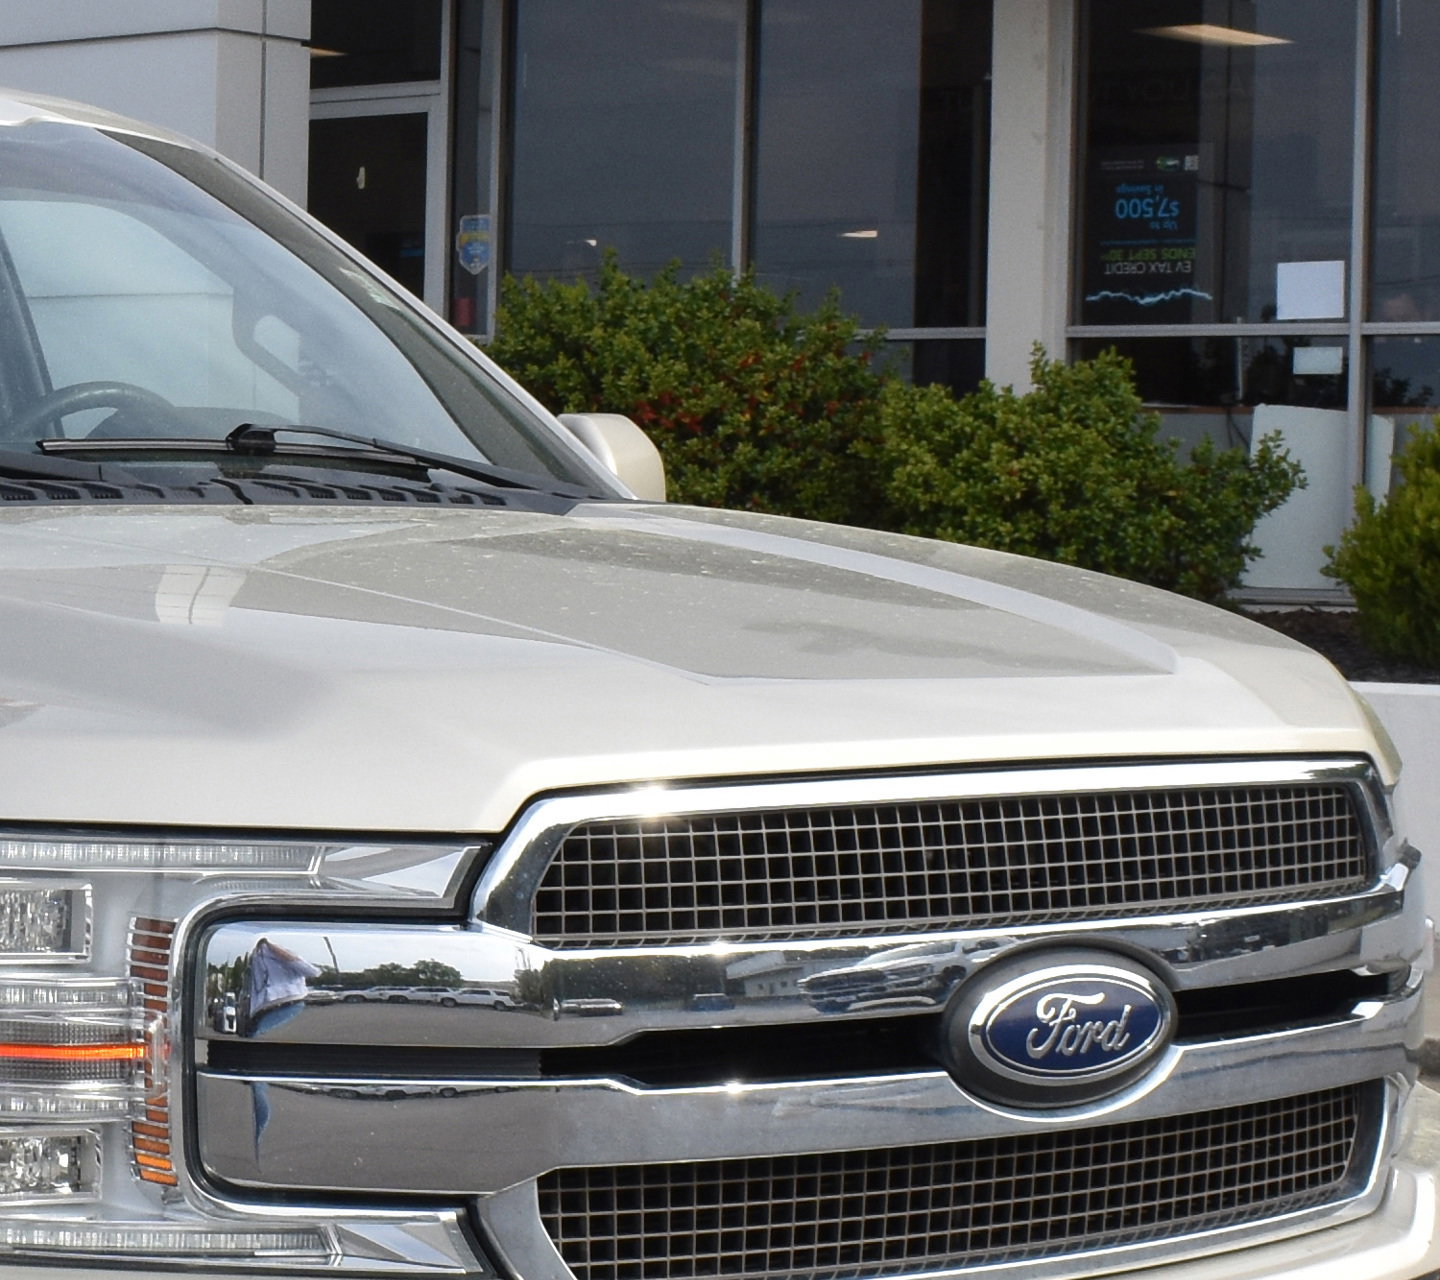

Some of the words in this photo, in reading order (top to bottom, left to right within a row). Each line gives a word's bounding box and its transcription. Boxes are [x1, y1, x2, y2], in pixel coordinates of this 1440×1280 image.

[1115, 195, 1179, 219] $7,500
[1104, 262, 1145, 275] CREDIT
[1149, 261, 1172, 273] TAX
[1026, 992, 1132, 1059] Ford
